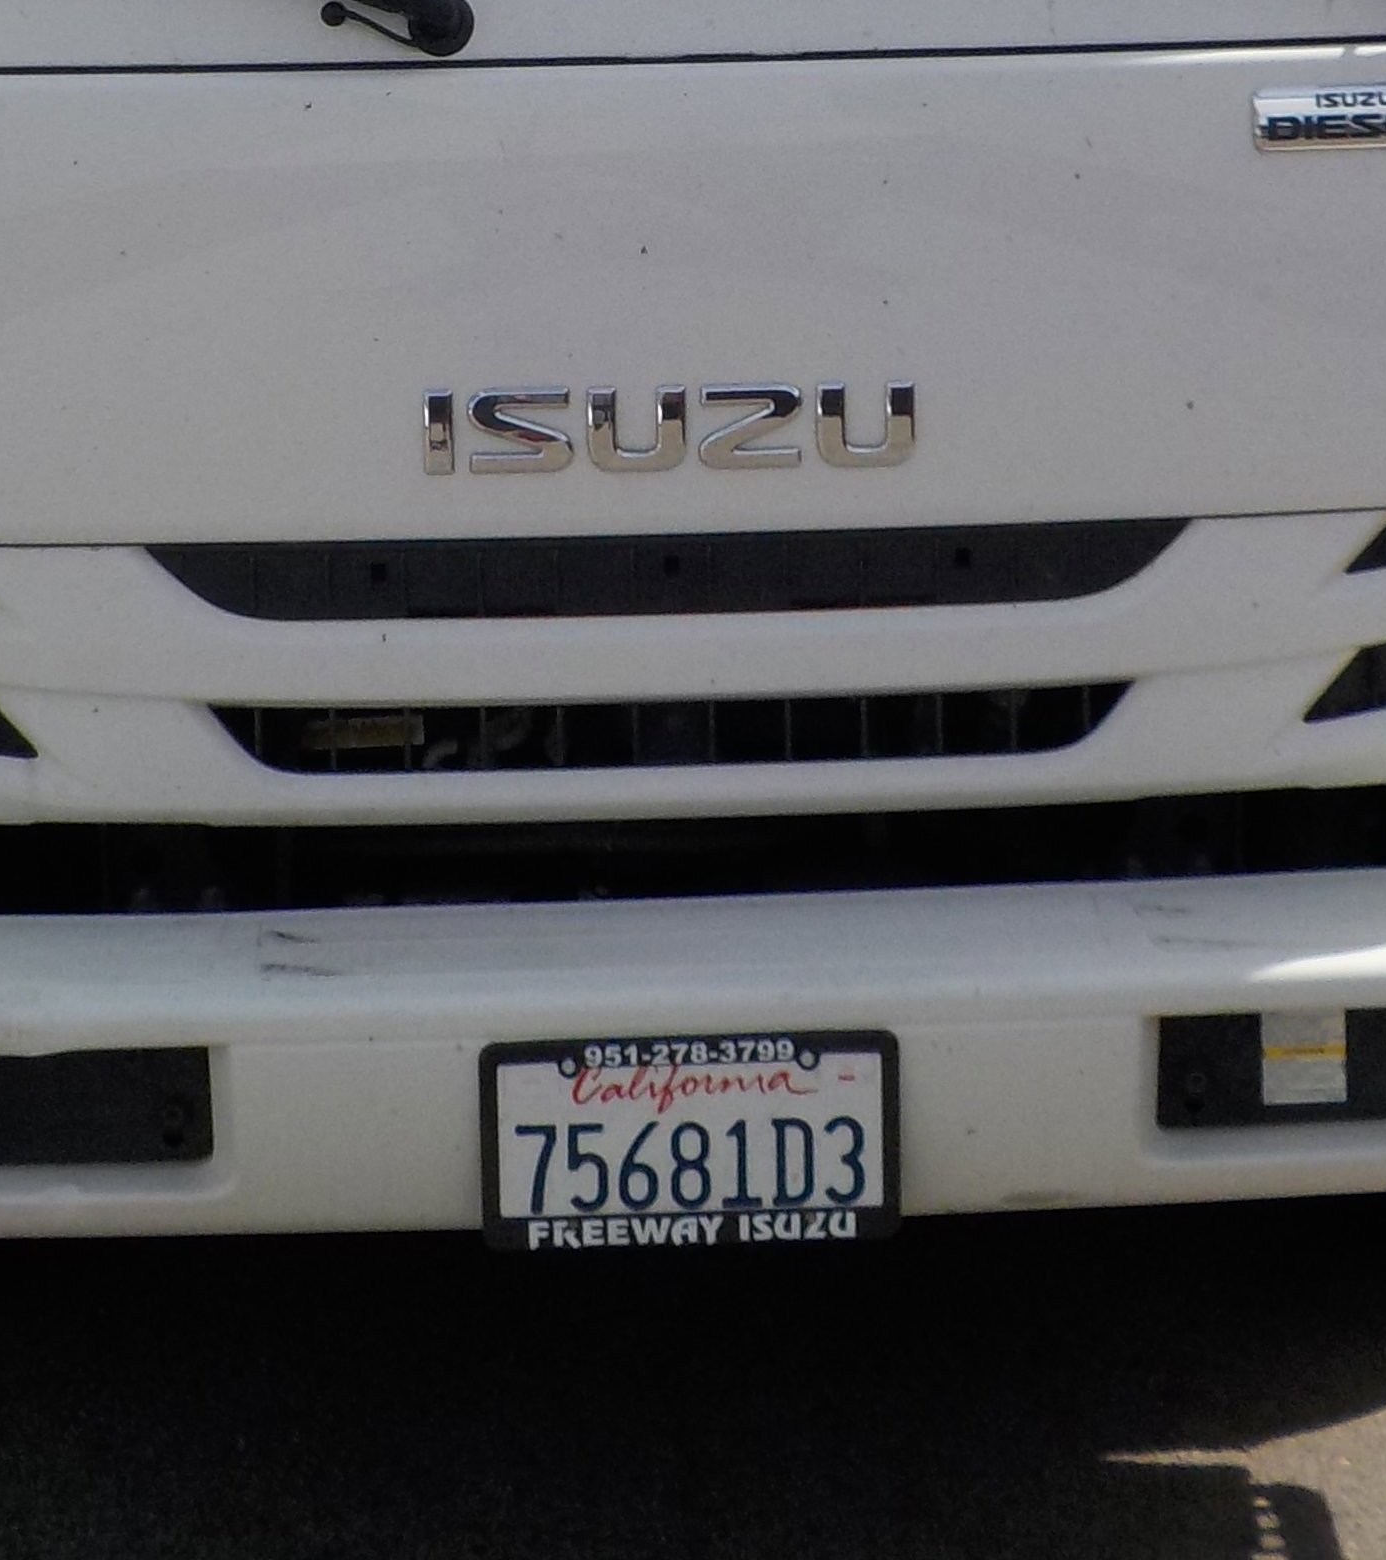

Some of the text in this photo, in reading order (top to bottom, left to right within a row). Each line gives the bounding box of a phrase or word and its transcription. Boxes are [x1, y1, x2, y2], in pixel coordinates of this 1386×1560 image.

[422, 380, 917, 476] ISUZU
[584, 1039, 796, 1068] 951-278-3799
[570, 1066, 818, 1114] California
[515, 1116, 865, 1213] 75681D3
[527, 1212, 857, 1249] FREEWAY ISUZU
